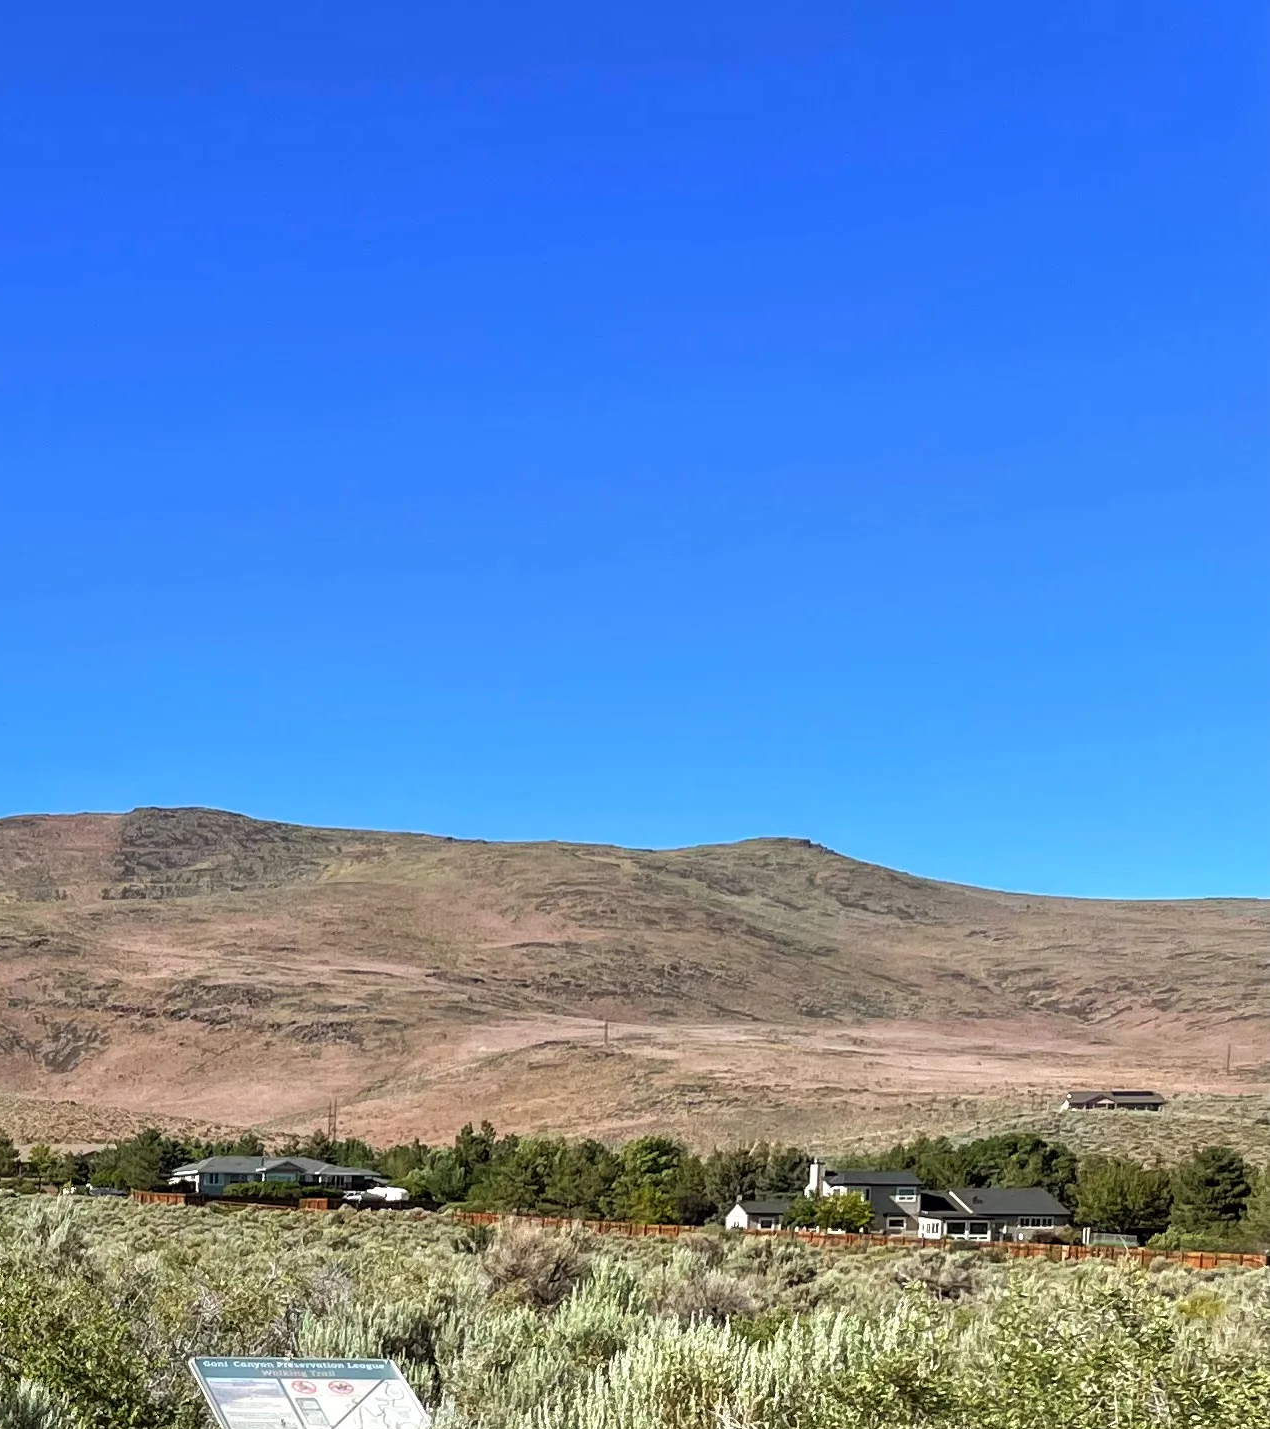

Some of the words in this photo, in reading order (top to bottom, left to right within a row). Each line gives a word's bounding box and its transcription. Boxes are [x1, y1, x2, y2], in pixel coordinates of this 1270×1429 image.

[232, 1360, 275, 1370] Canyon
[276, 1361, 345, 1369] Preservation
[346, 1362, 385, 1371] League
[261, 1370, 308, 1378] Walking
[310, 1370, 337, 1378] Trail
